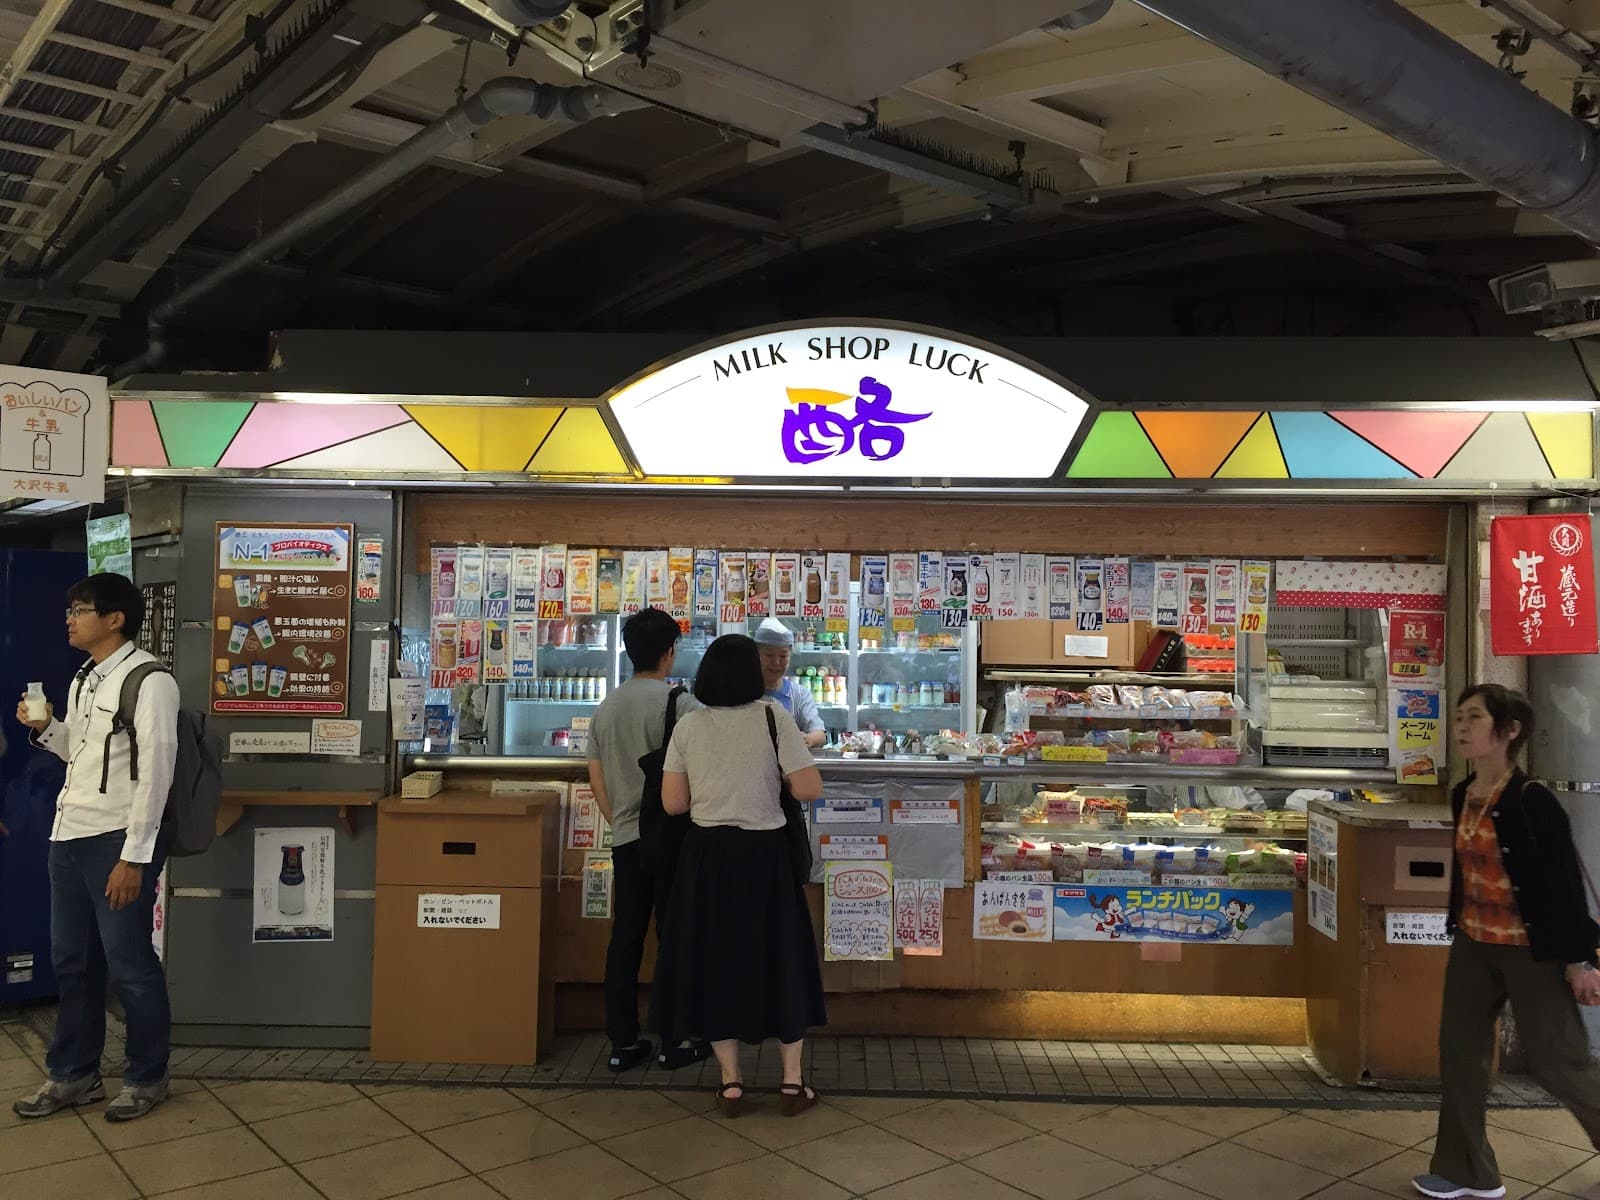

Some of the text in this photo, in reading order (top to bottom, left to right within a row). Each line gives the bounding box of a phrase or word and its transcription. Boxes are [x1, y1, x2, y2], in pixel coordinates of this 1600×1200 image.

[713, 336, 989, 384] MILK SHOP LUCK
[4, 392, 81, 413] おいしいパン
[26, 418, 60, 432] 牛乳
[14, 480, 70, 493] 大沢牛乳
[233, 543, 268, 560] N-1
[274, 540, 328, 551] プロバイオティクス
[1512, 550, 1546, 612] 甘酒
[1558, 564, 1581, 627] 蔵元造り
[1403, 623, 1429, 640] R-1
[1125, 890, 1221, 910] ランチパック
[423, 916, 487, 925] 入れないでください
